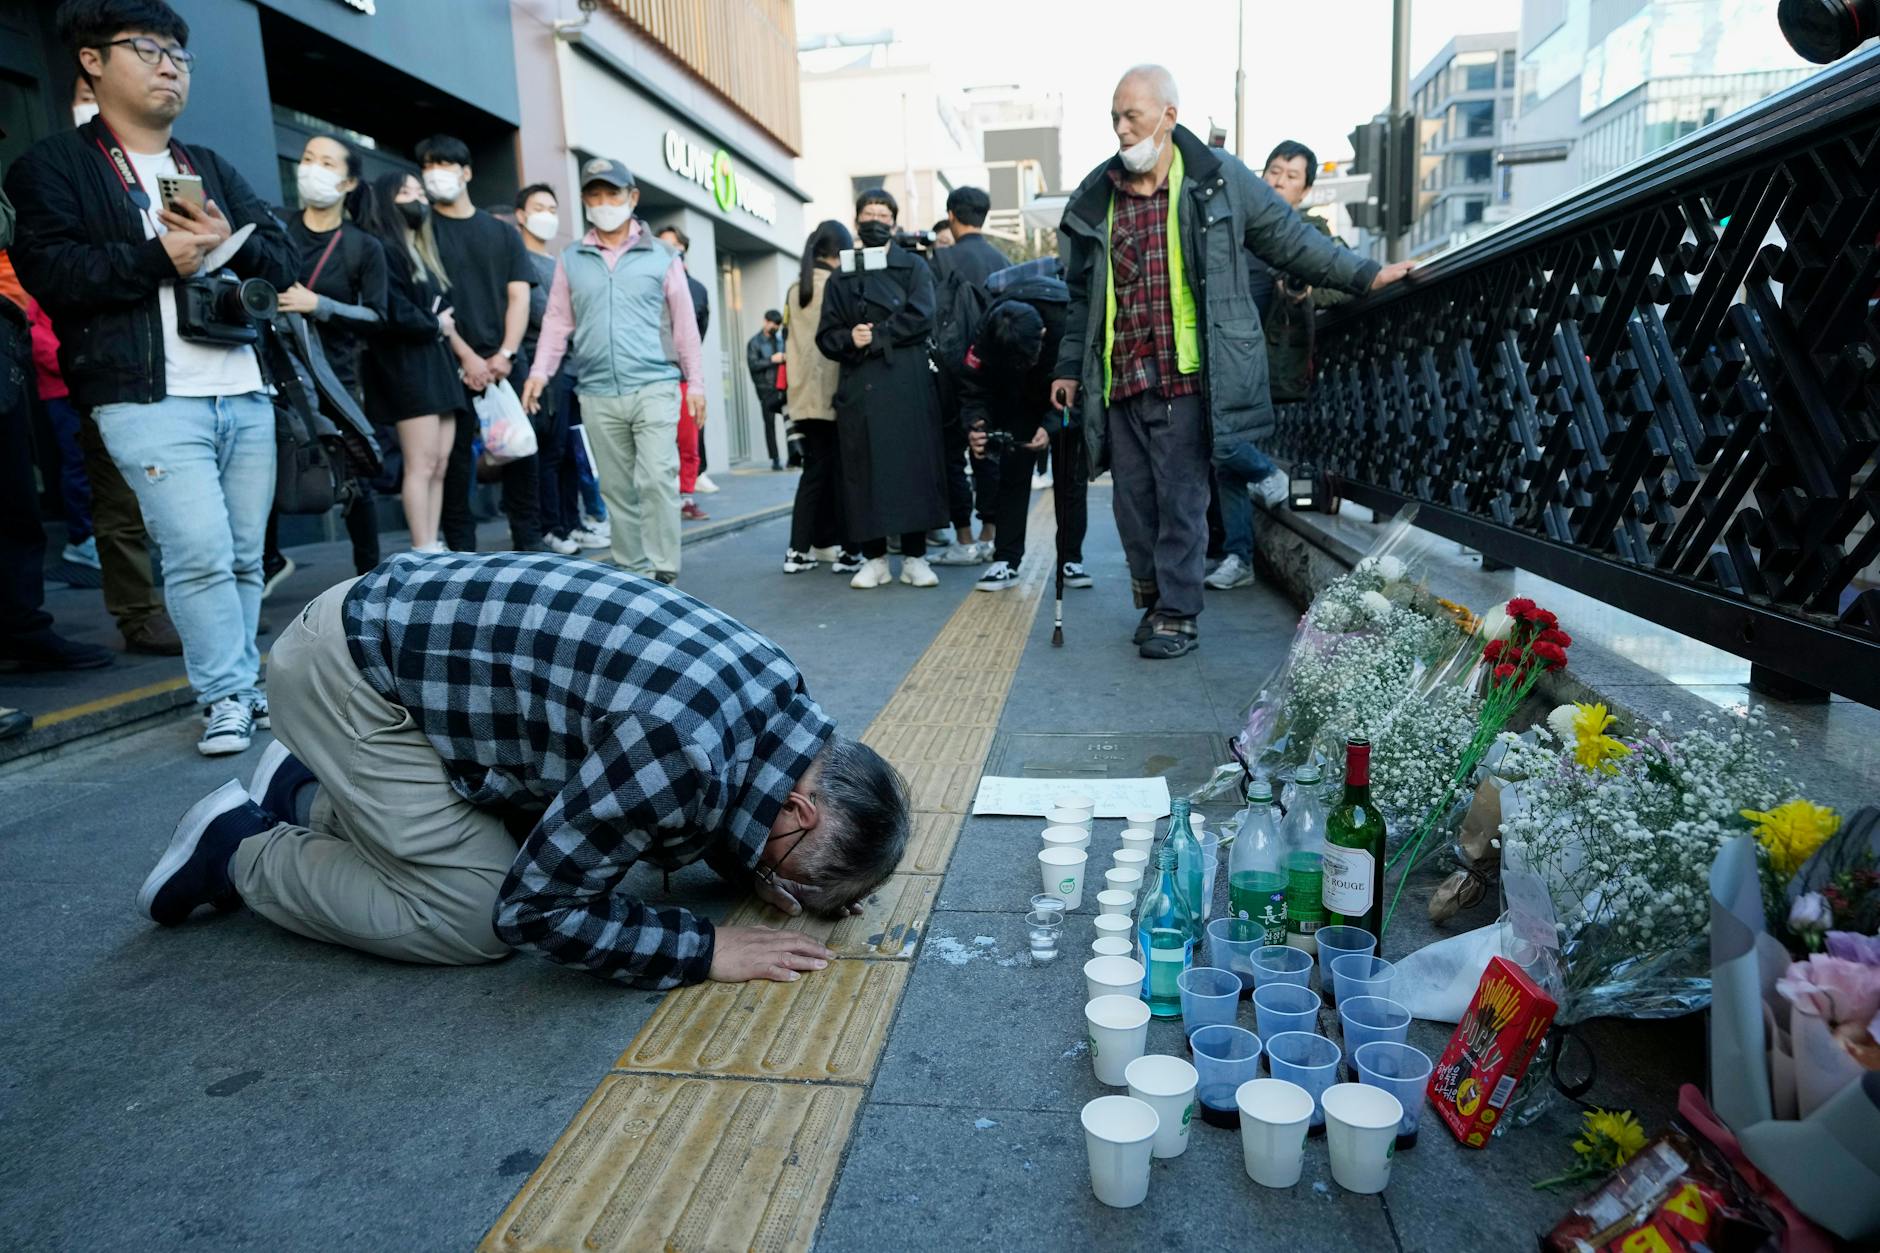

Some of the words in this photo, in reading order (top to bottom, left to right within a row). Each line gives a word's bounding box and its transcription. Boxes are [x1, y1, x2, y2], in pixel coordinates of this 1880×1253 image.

[110, 147, 136, 184] Canon
[665, 128, 714, 191] OLIVE
[1331, 878, 1365, 891] ROUGE
[1458, 1010, 1503, 1072] POCKY
